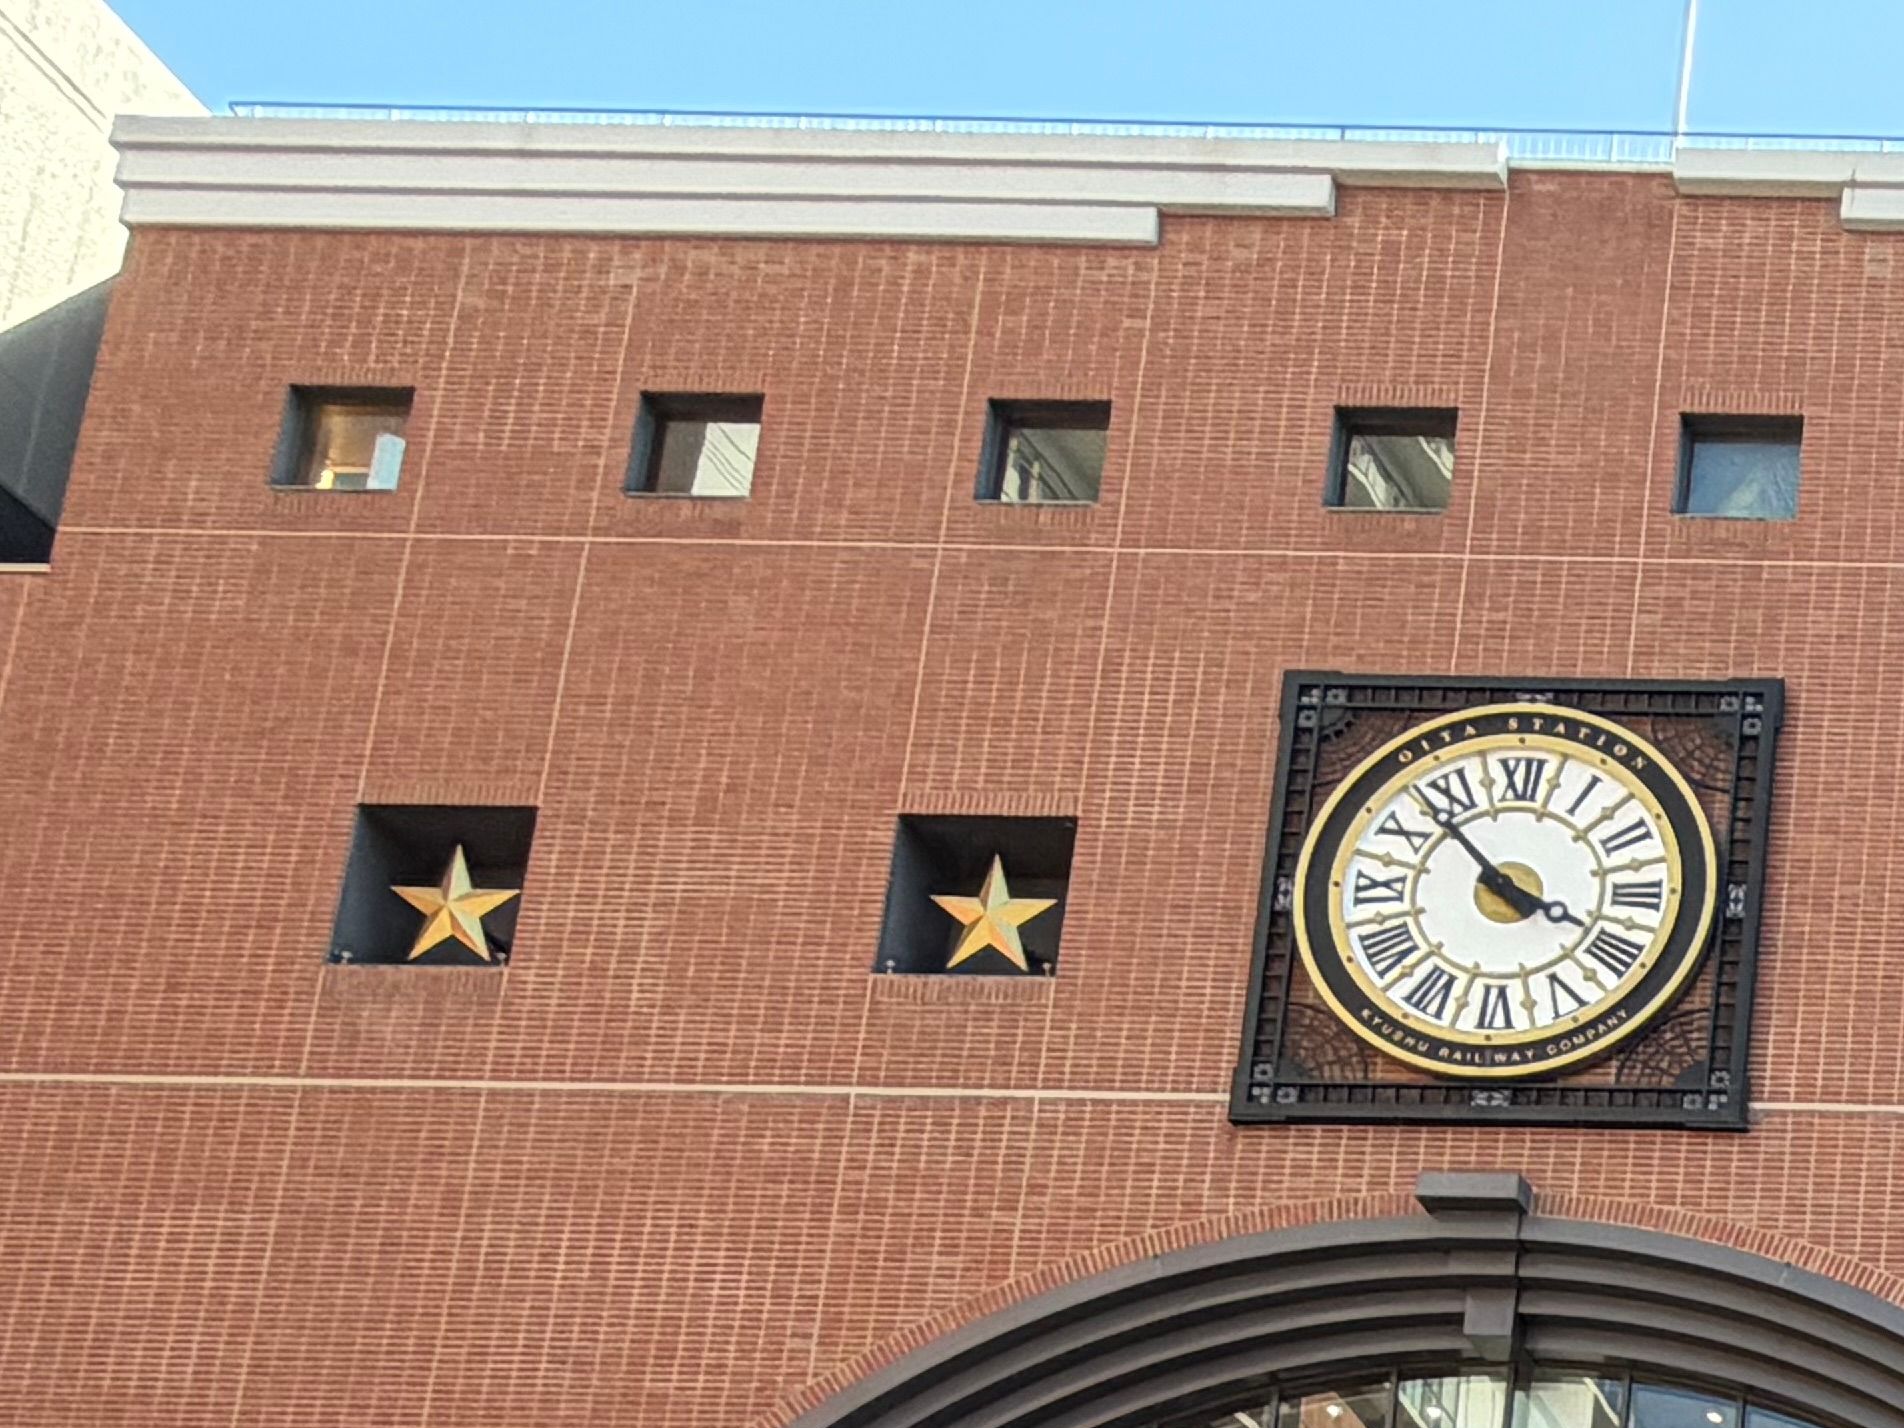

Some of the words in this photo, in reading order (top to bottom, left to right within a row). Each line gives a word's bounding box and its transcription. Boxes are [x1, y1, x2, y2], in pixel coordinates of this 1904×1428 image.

[1398, 724, 1477, 763] OITA
[1508, 717, 1647, 769] STATION
[1498, 757, 1549, 802] XII
[1360, 1008, 1430, 1052] KYUSHU
[1546, 1008, 1629, 1056] COMPANY
